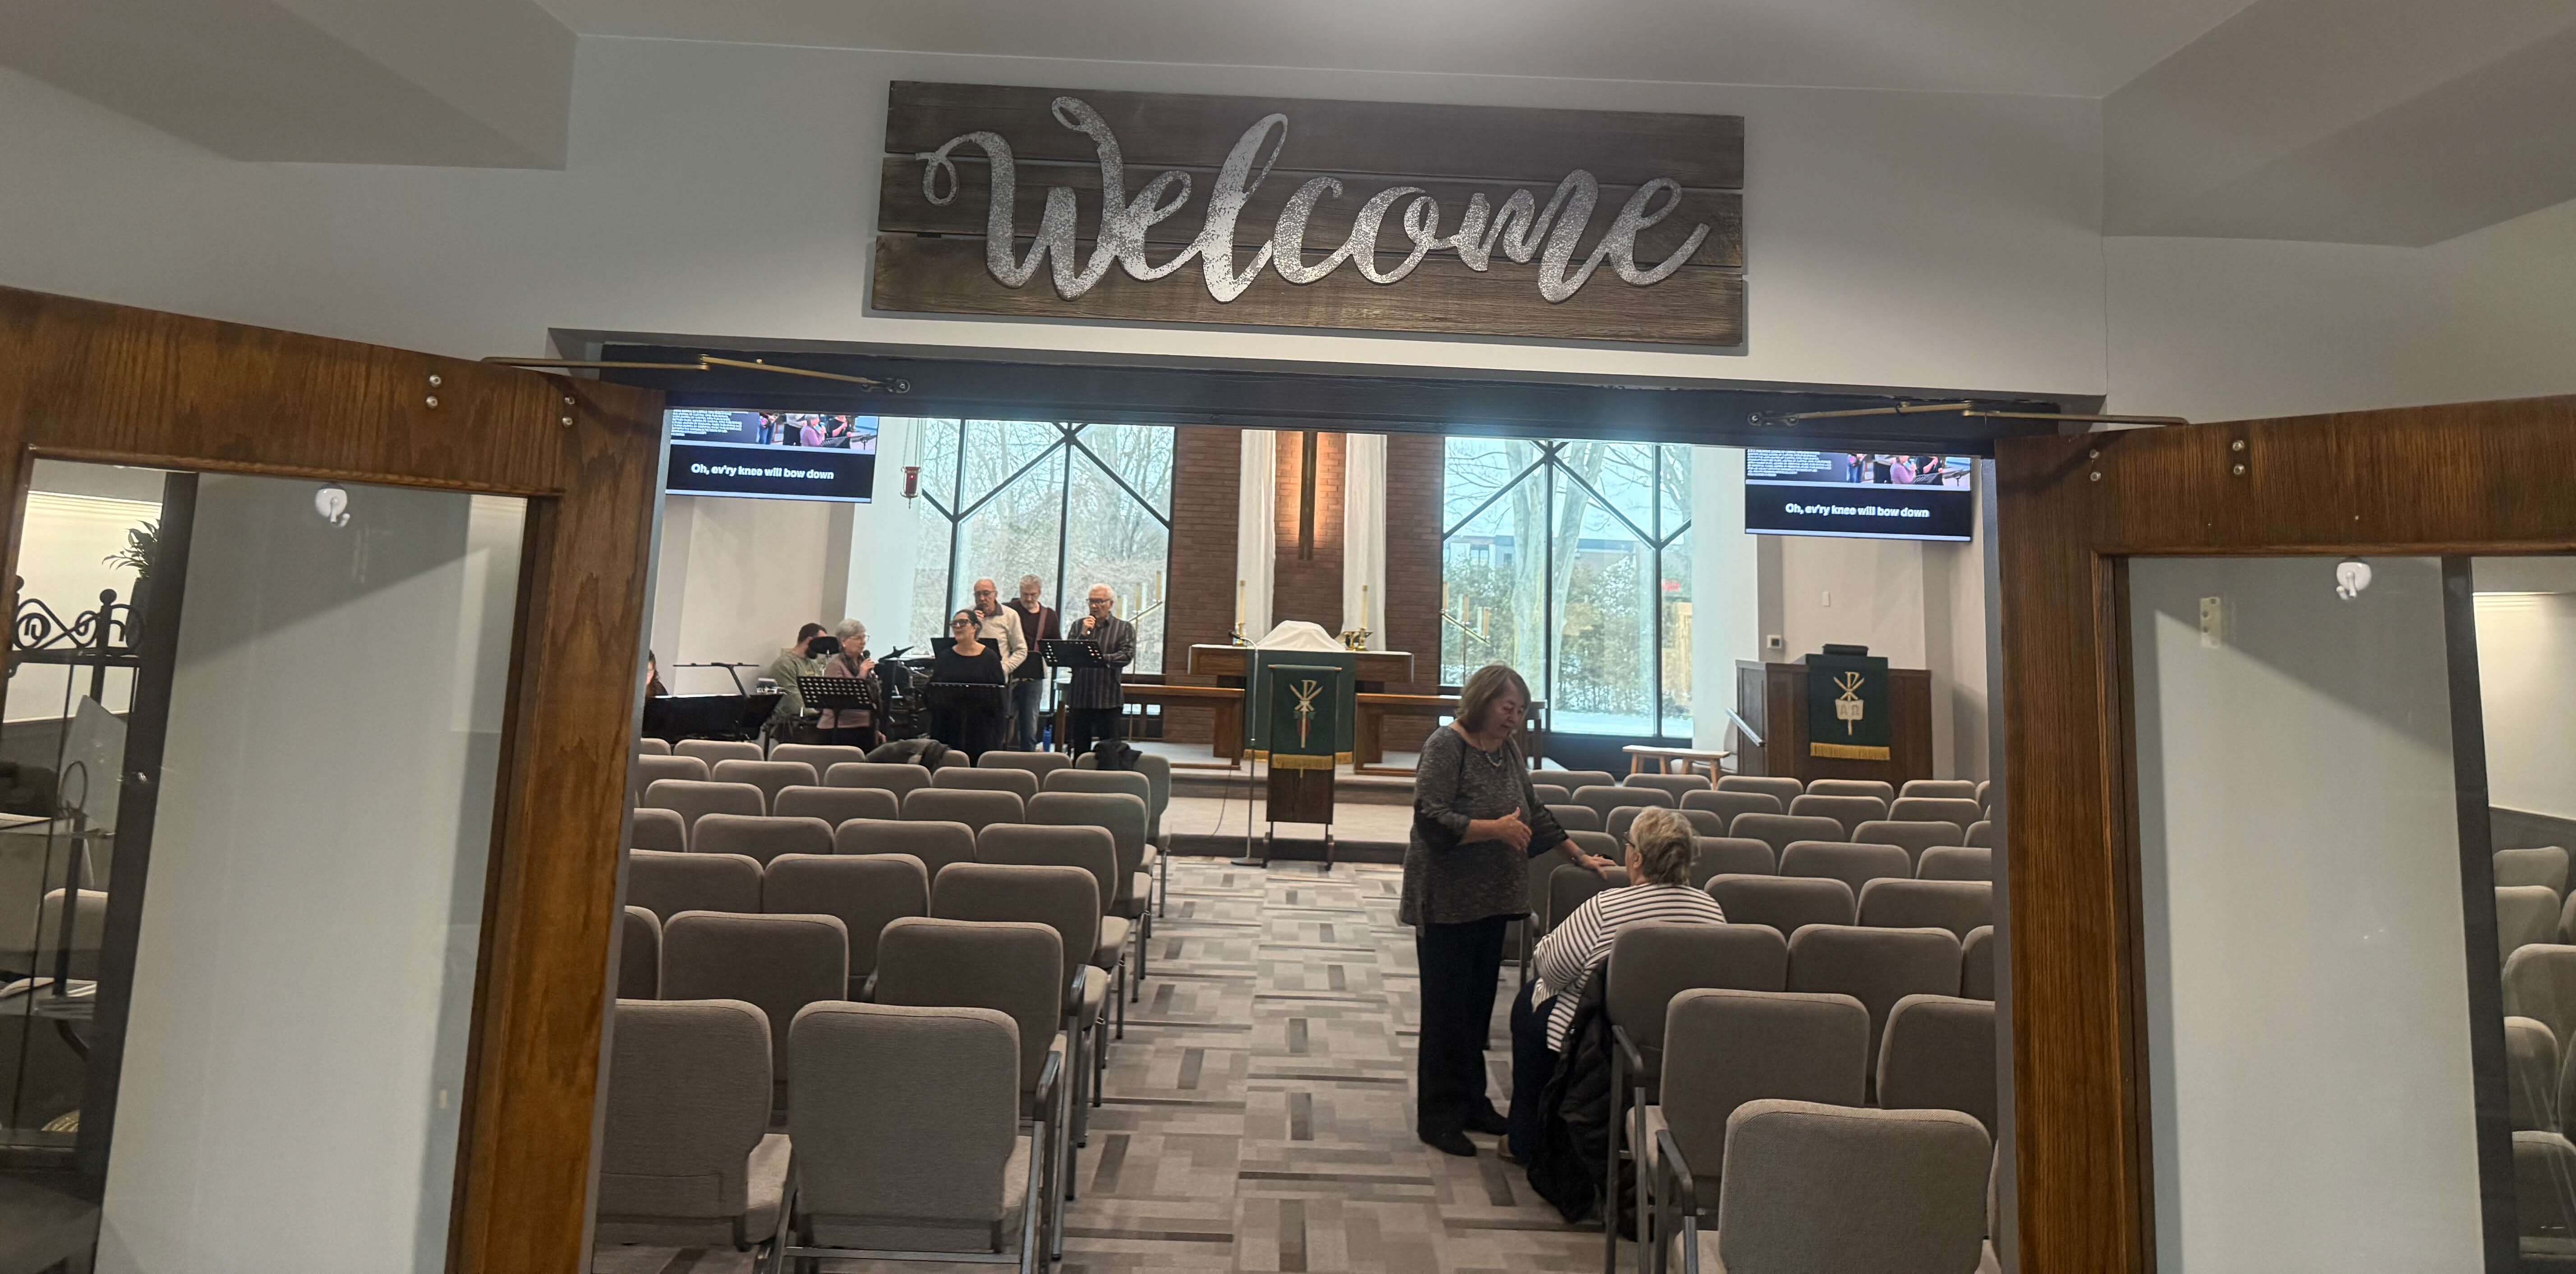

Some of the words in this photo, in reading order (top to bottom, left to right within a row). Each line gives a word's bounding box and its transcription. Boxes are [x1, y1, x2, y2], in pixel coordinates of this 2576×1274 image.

[915, 96, 1711, 303] Welcome
[691, 464, 709, 475] Oh,
[738, 466, 763, 476] knee
[764, 468, 782, 477] will
[783, 468, 805, 478] bow
[806, 469, 834, 479] down
[1785, 503, 1804, 514] Oh,
[1831, 505, 1857, 515] knee
[1858, 506, 1876, 515] will
[1877, 506, 1900, 516] bow
[1900, 507, 1929, 517] down
